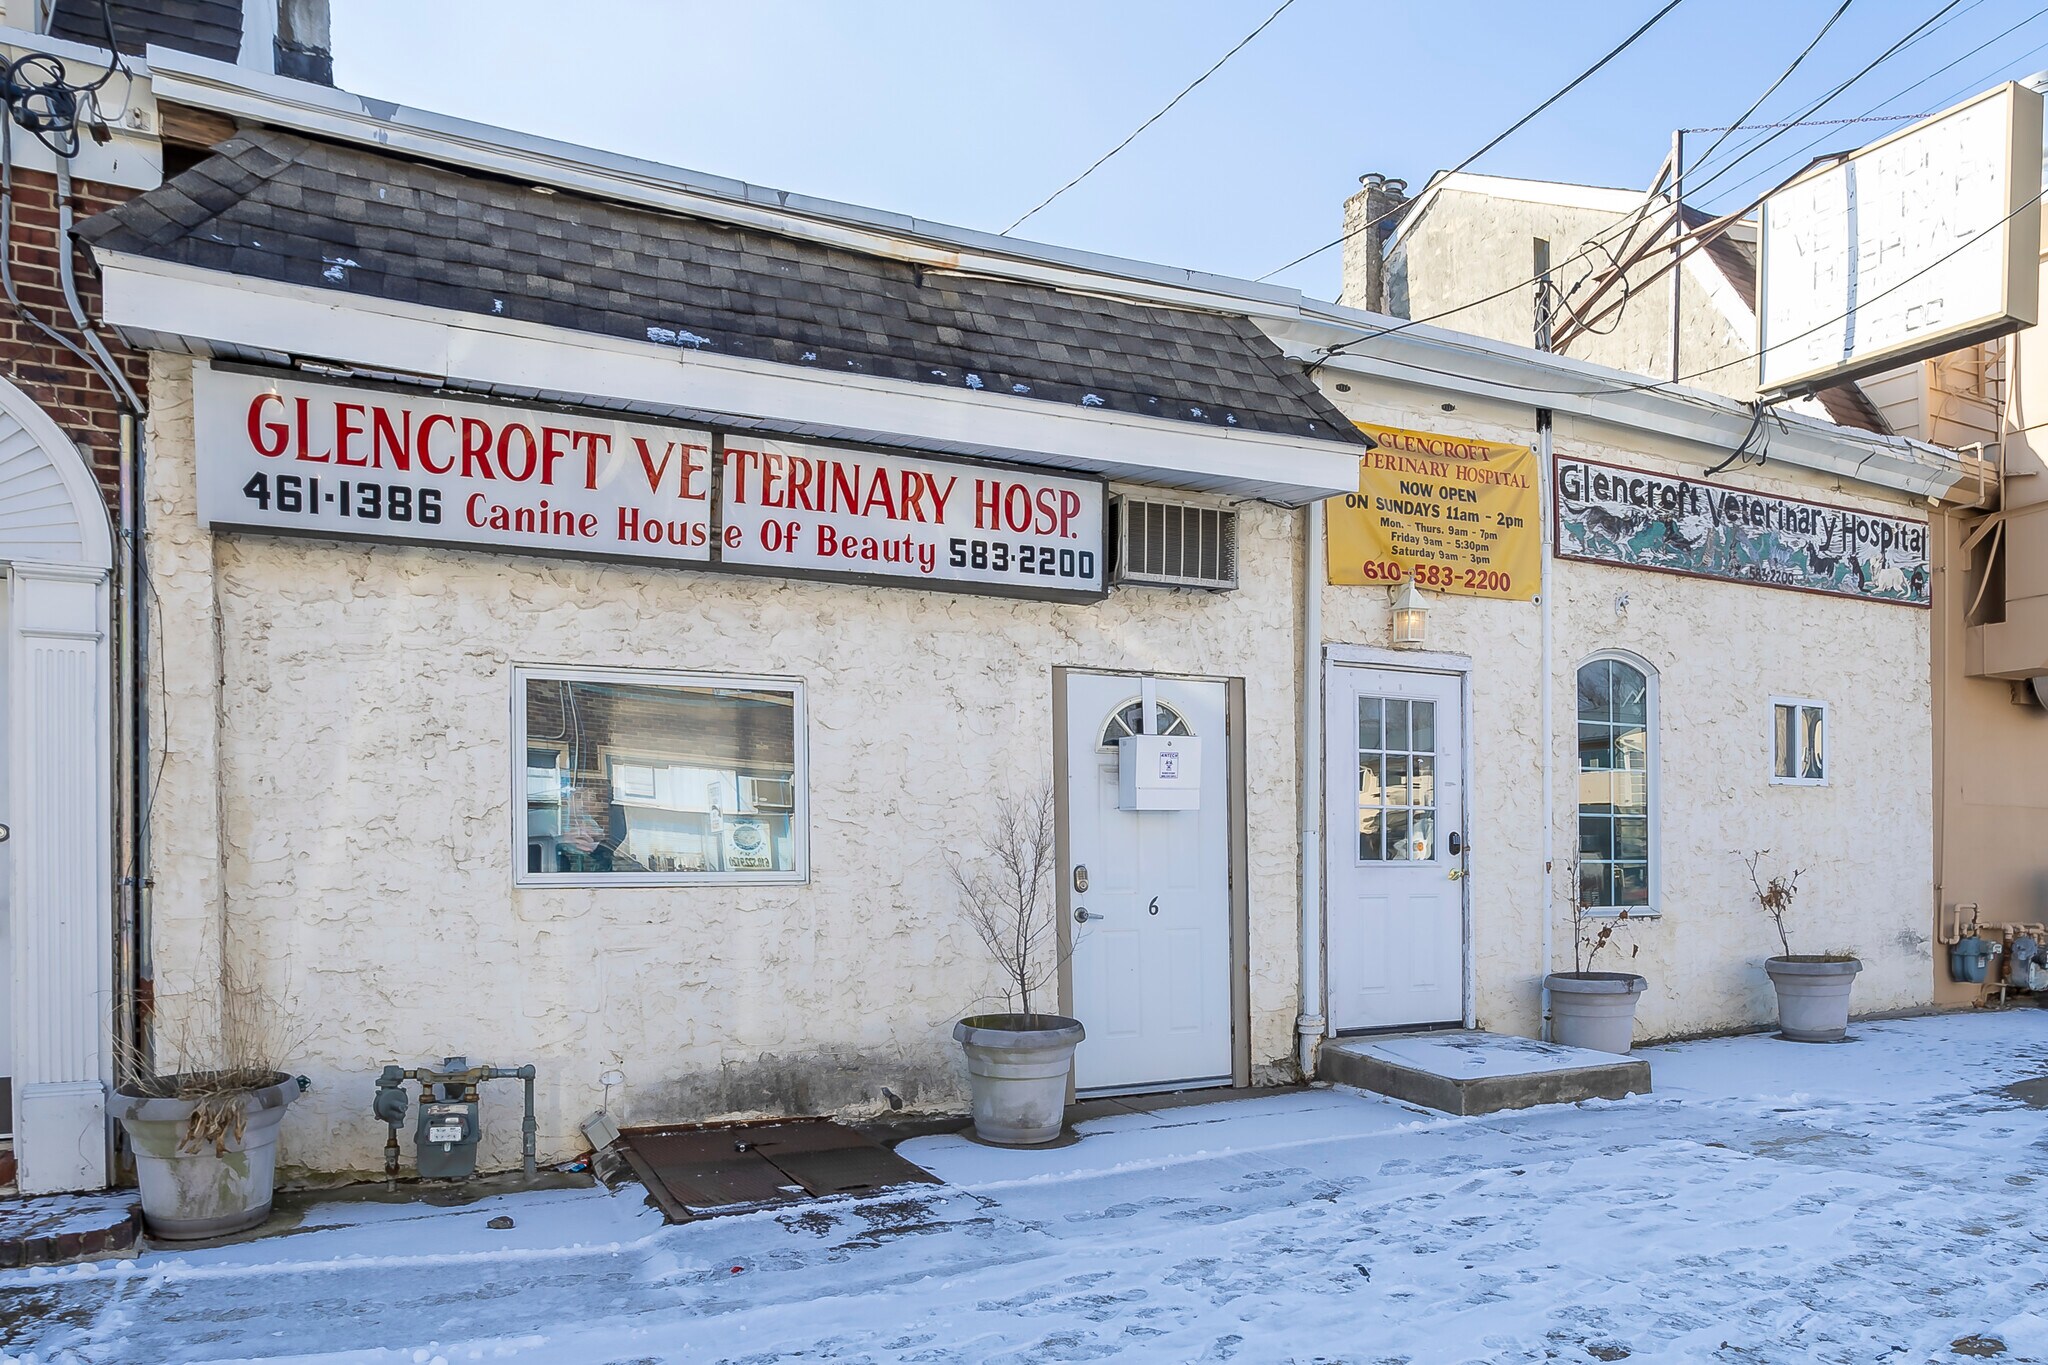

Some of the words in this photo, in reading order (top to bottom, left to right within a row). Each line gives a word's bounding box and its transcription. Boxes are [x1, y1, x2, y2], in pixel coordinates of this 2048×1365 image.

[1378, 432, 1490, 462] GLENCROFT
[247, 393, 611, 490] GLENCROFT
[975, 478, 1082, 539] HOSP.
[1362, 452, 1449, 478] TERINARY
[1456, 464, 1531, 489] HOSPITAL
[1399, 480, 1433, 498] NOW
[1439, 486, 1477, 503] OPEN
[1345, 493, 1369, 509] ON
[1376, 497, 1440, 518] SUNDAYS
[1446, 506, 1479, 522] 11am
[1496, 512, 1523, 528] 2pm
[1559, 465, 1701, 518] Glencroft
[1705, 488, 1836, 551] Veterinary
[1843, 514, 1927, 561] Hospital
[466, 491, 598, 537] Canine
[617, 507, 743, 549] House
[760, 518, 801, 554] Of
[817, 524, 936, 574] Beauty
[1380, 517, 1404, 529] Mon.
[1415, 522, 1445, 534] Thurs.
[1448, 525, 1468, 537] 9am
[1480, 529, 1498, 540] 7pm
[1391, 532, 1420, 545] Friday
[1423, 536, 1443, 547] 9am
[1455, 540, 1489, 552] 5:30pm
[1391, 546, 1436, 560] Saturday
[1438, 551, 1458, 561] 9am
[1470, 553, 1490, 564] 3pm
[1363, 560, 1511, 592] 610-583-2200
[1149, 896, 1159, 915] 6
